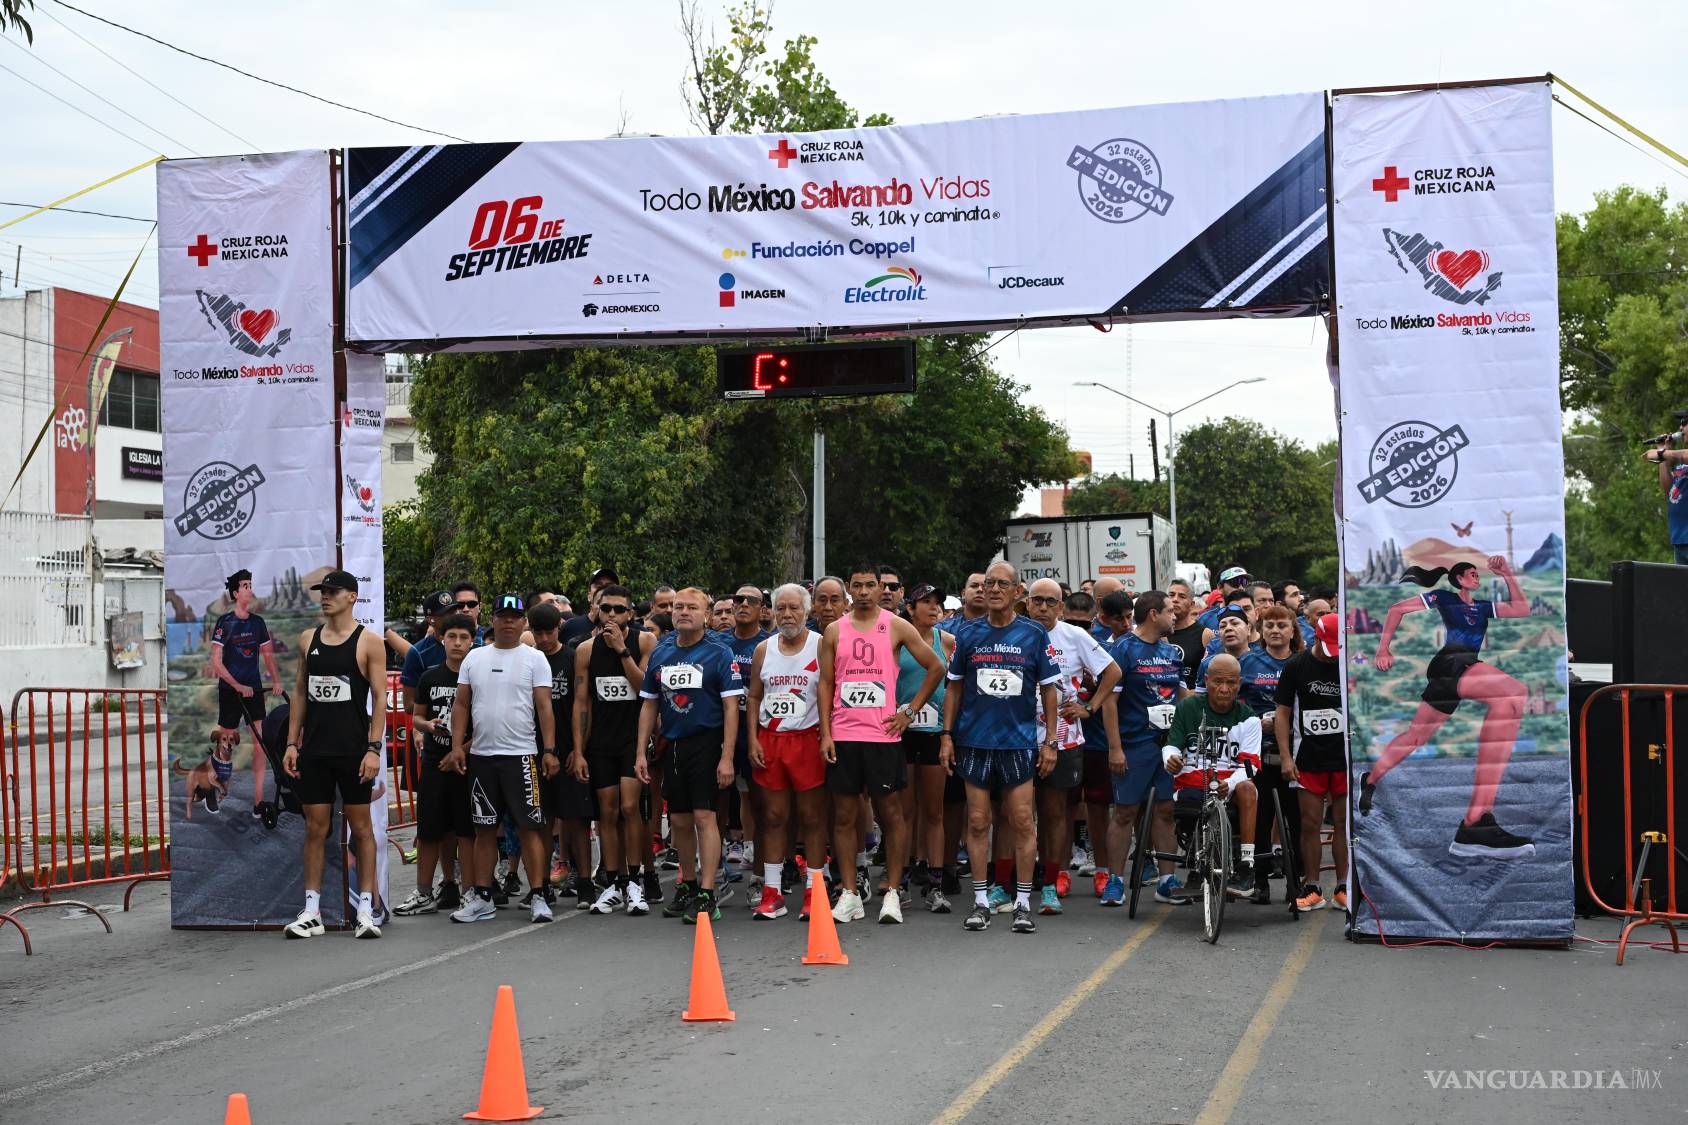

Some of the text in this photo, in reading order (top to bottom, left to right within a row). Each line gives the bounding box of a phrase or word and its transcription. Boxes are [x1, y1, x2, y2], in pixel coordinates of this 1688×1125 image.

[800, 140, 865, 152] CRUZ ROJA
[800, 151, 865, 164] MEXICANA
[1107, 144, 1153, 176] 32 estados
[1414, 166, 1496, 182] CRUZ ROJA
[640, 175, 991, 213] Todo México Salvando Vidas
[1092, 163, 1168, 211] EDICIÓN
[1414, 180, 1496, 195] MEXICANA
[1087, 193, 1124, 218] 2026
[468, 195, 565, 251] 06 DE
[851, 211, 874, 229] 5k,
[879, 209, 906, 226] 10k
[909, 212, 920, 227] y
[221, 234, 289, 248] CRUZ ROJA
[752, 236, 915, 259] Fundación Coppel
[221, 247, 289, 261] MEXICANA
[445, 233, 593, 281] SEPTIEMBRE
[606, 273, 650, 284] DELTA
[998, 276, 1065, 290] JCDecaux
[740, 289, 786, 300] IMAGEN
[844, 285, 926, 304] Electrolit
[601, 304, 660, 314] AEROMEXICO
[1355, 311, 1531, 330] Todo México Salvando Vidas
[173, 362, 314, 380] Todo México Salvando Vidas
[1375, 427, 1425, 462] 32 estados
[1385, 431, 1465, 486] EDICIÓN
[189, 467, 227, 498] 32 estados
[1410, 475, 1448, 503] 2026
[195, 469, 262, 520] EDICIÓN
[214, 510, 247, 535] 2026
[974, 643, 1022, 655] Todo México
[669, 673, 692, 686] 661
[769, 675, 809, 687] CERRITOS
[989, 678, 1008, 691] 43
[315, 685, 341, 698] 367
[603, 685, 628, 698] 593
[849, 691, 876, 704] 474
[772, 702, 796, 714] 291
[1310, 717, 1339, 731] 690
